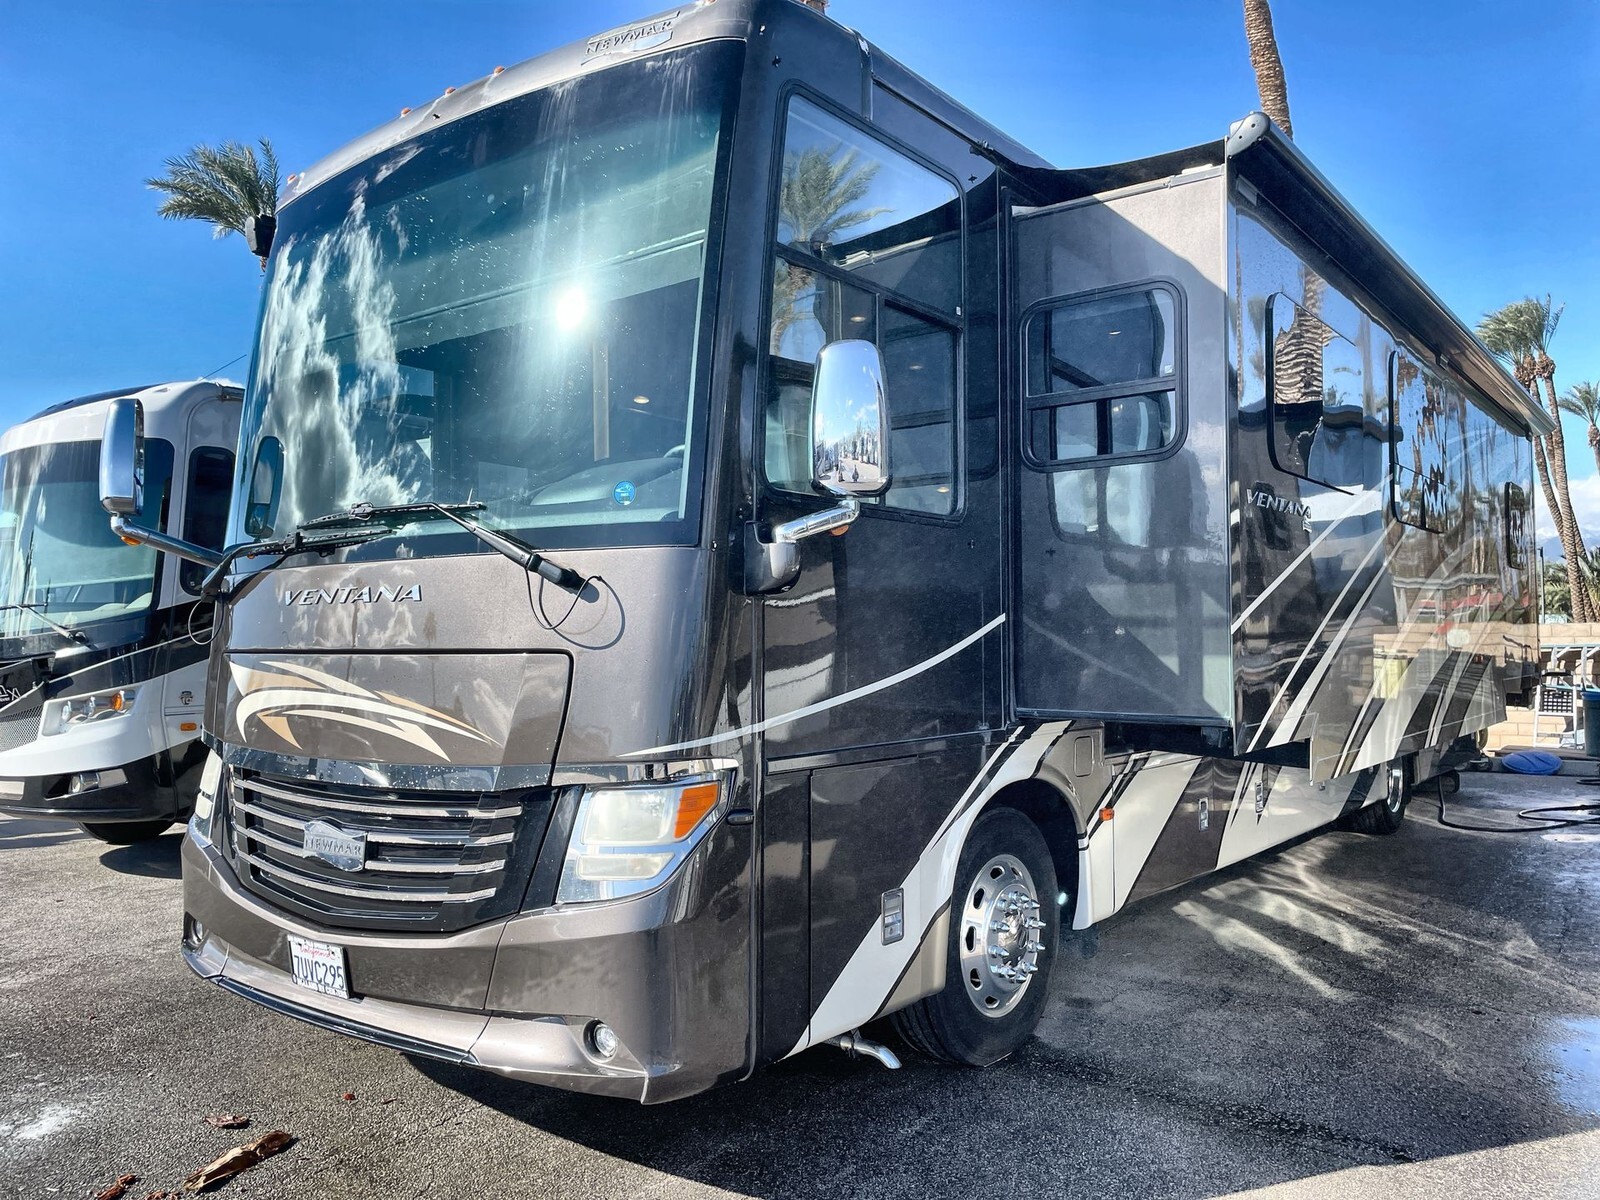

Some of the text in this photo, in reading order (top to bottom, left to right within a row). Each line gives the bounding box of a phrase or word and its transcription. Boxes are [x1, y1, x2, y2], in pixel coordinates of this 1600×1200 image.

[585, 20, 673, 55] NEWMAR
[1246, 490, 1312, 519] VENTANA
[284, 583, 422, 606] VENTANA
[305, 836, 361, 856] NEWMAR
[293, 954, 345, 990] 7UVC295
